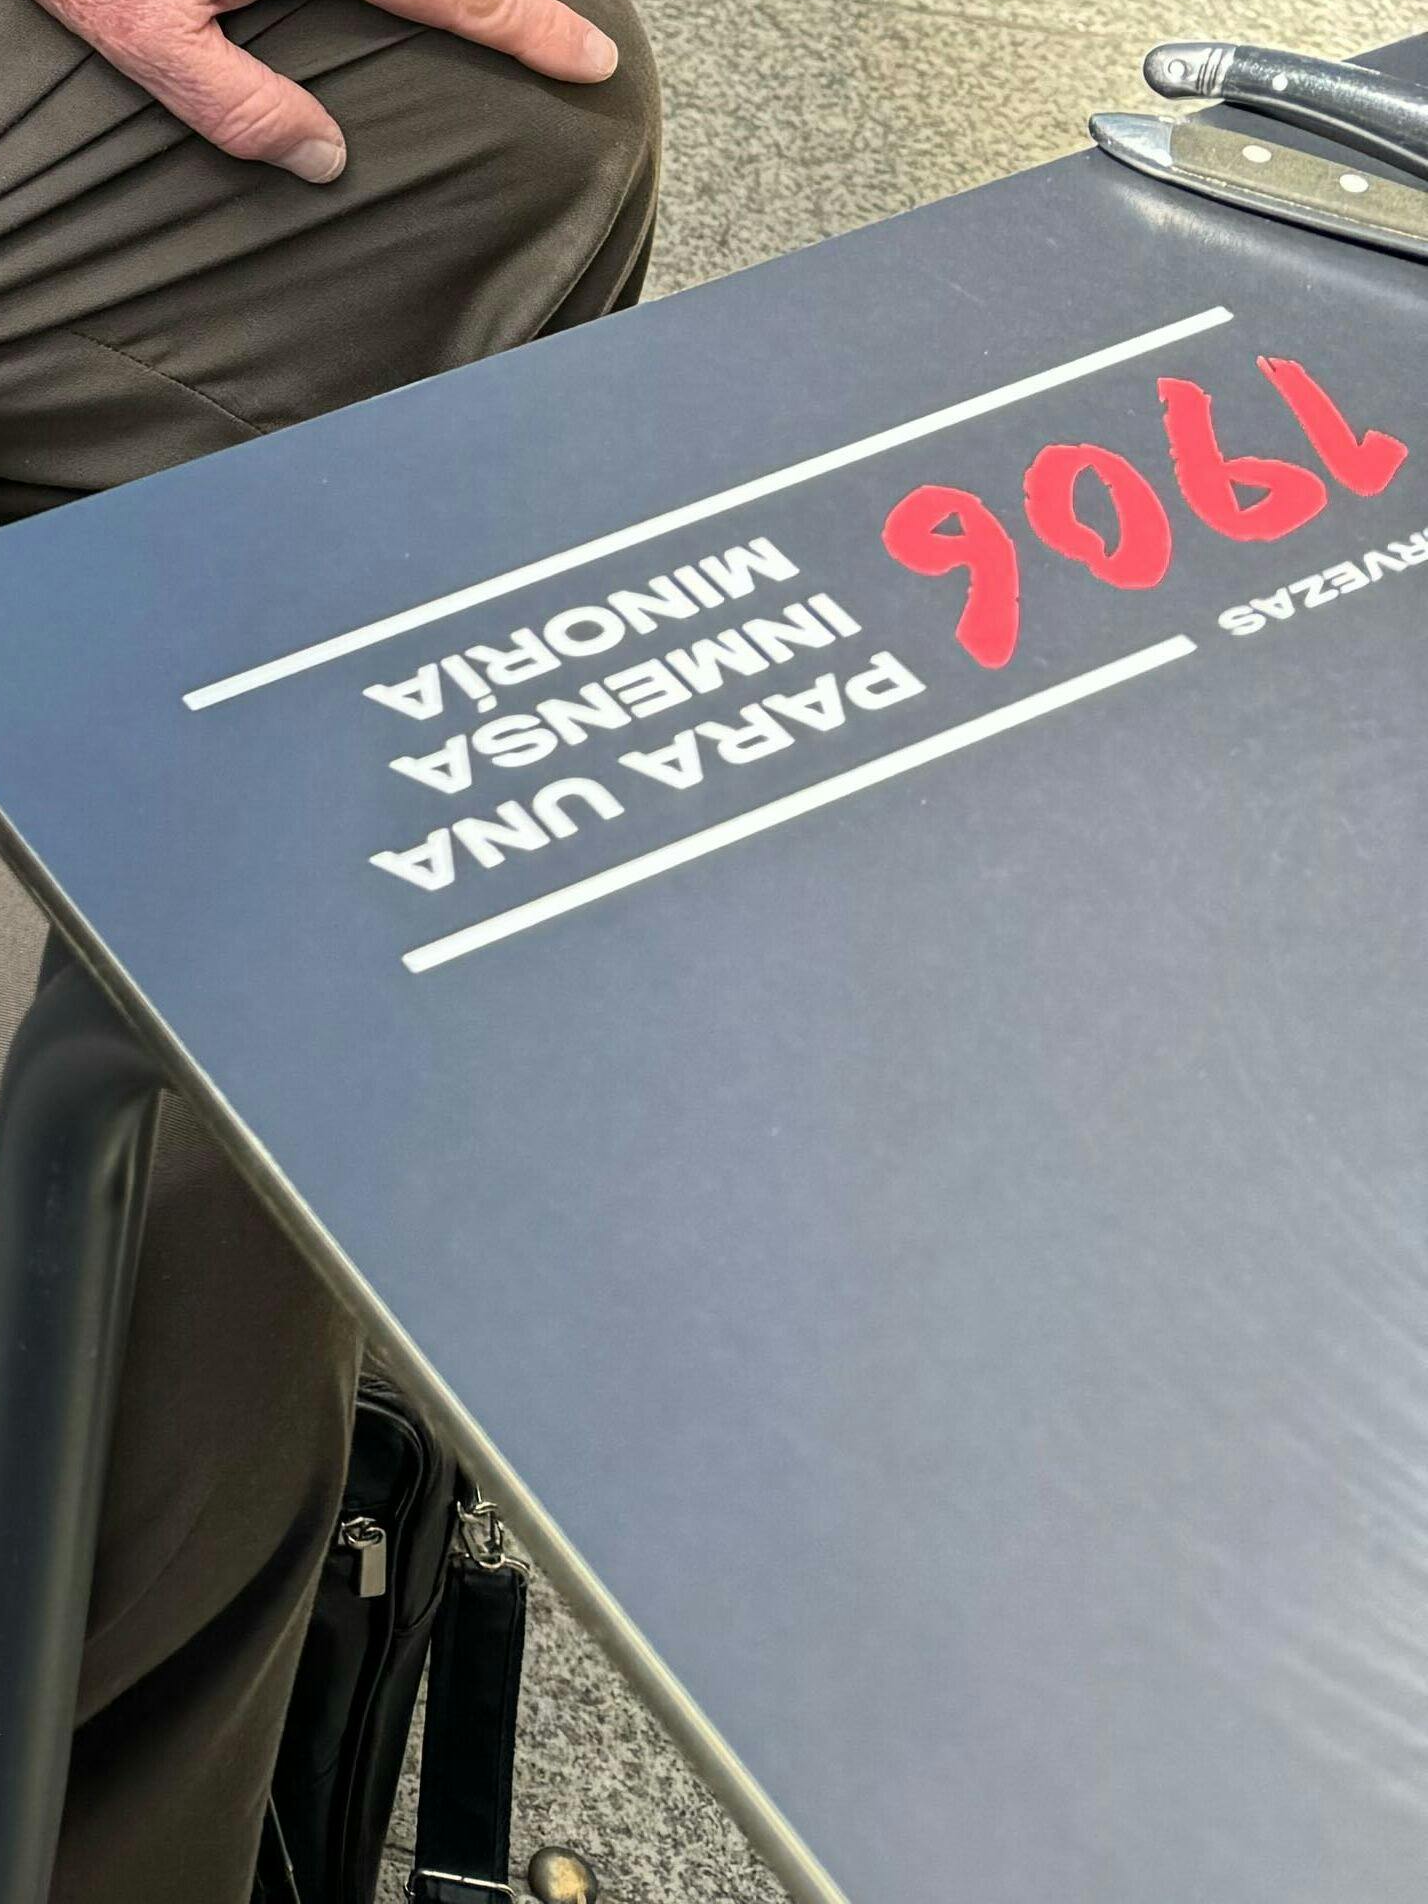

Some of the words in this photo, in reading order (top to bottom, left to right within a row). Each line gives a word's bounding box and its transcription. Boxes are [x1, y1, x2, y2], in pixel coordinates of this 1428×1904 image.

[882, 354, 1408, 668] 1906
[1217, 526, 1428, 637] RVEZAS
[361, 535, 800, 722] MINORÍA
[388, 592, 863, 794] INMENSA
[617, 649, 927, 791] PARA
[367, 775, 626, 892] UNA
